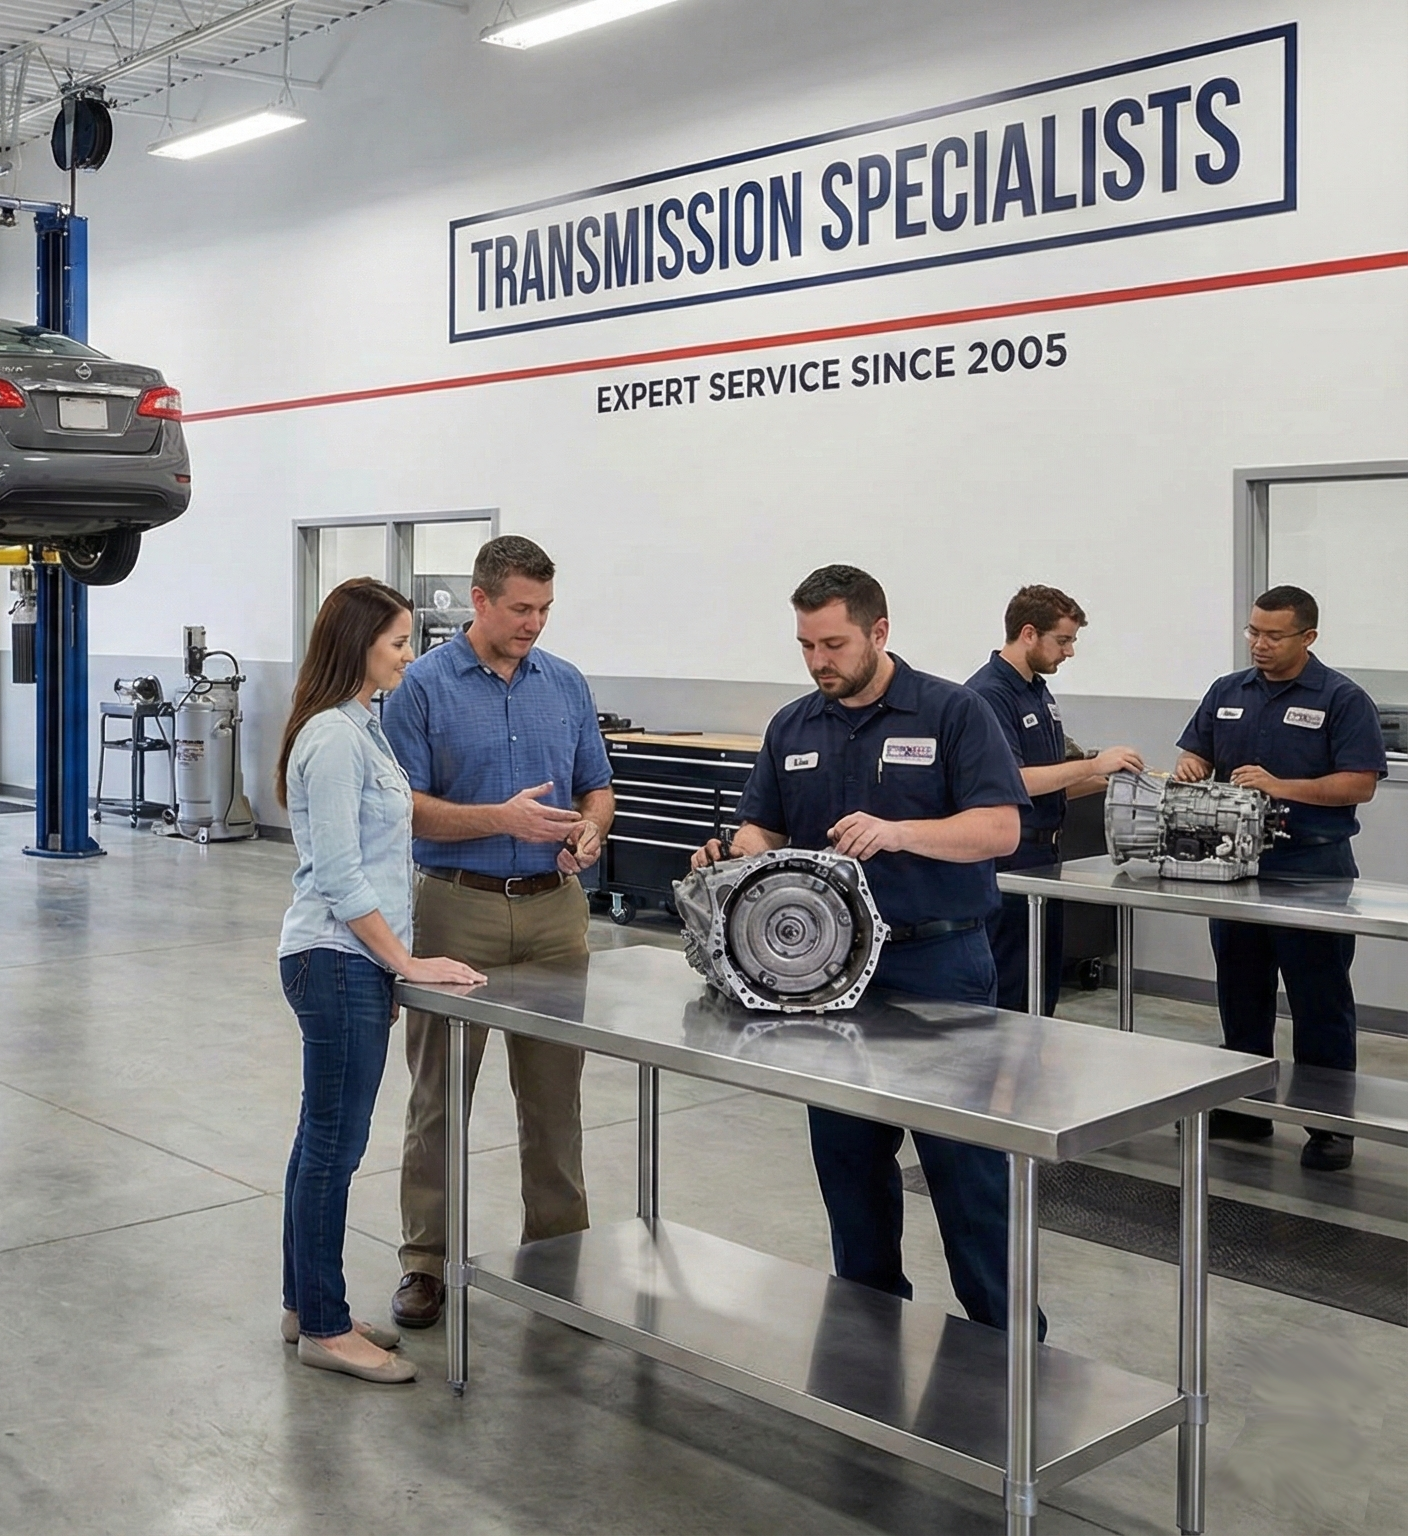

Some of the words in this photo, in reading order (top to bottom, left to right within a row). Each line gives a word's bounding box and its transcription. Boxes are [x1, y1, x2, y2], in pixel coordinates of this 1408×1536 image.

[470, 171, 802, 313] TRANSMISSION
[820, 77, 1242, 252] SPECIALISTS
[596, 375, 701, 414] EXPERT
[708, 358, 841, 402] SERVICE
[850, 345, 956, 388] SINCE
[967, 332, 1068, 375] 2005
